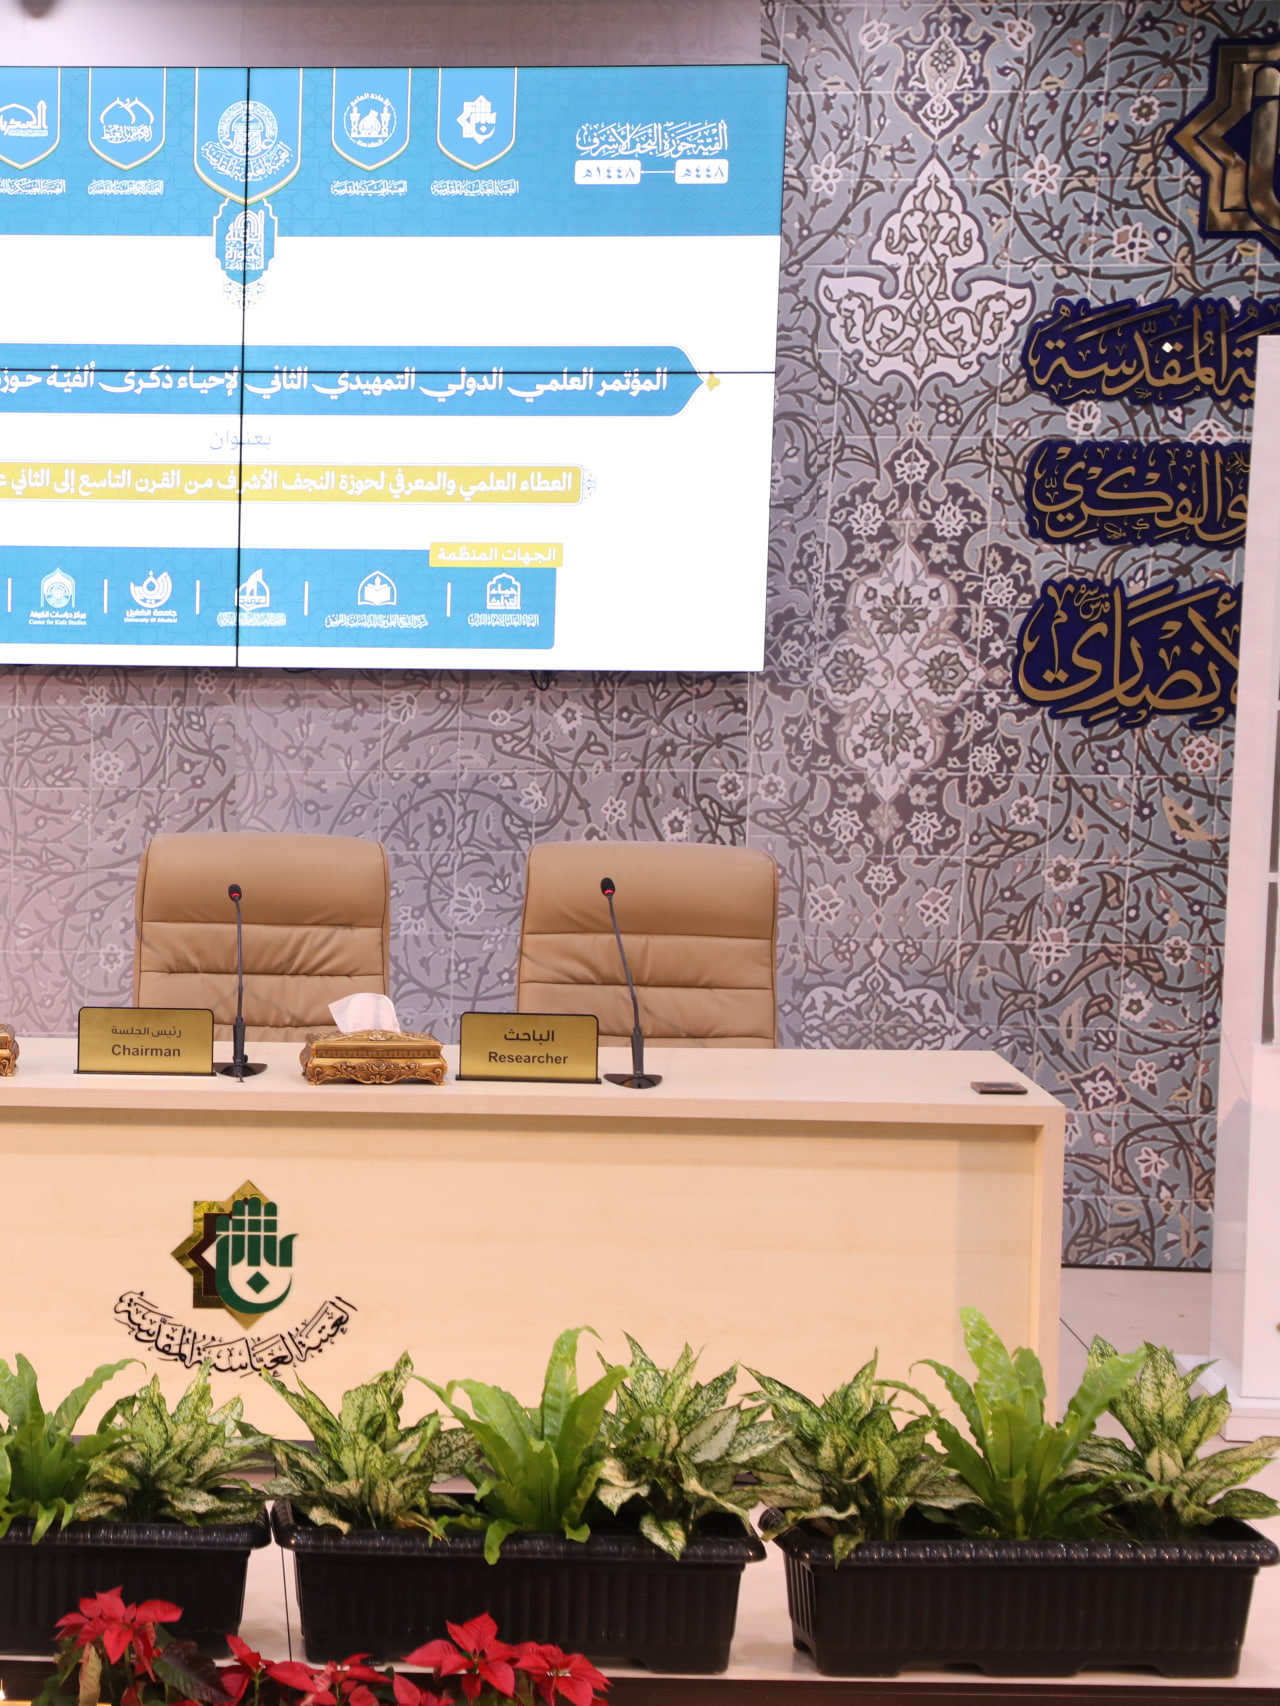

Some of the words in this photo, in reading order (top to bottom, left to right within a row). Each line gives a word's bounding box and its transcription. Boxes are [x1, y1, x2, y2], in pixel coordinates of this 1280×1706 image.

[177, 366, 240, 396] لإحياء
[244, 365, 307, 400] الثاني
[312, 367, 415, 400] التمهيدي
[419, 367, 503, 402] الدولي
[507, 367, 593, 402] العلمي
[597, 367, 667, 397] المؤتمر
[10, 469, 50, 494] الثاني
[53, 470, 75, 495] إلى
[80, 470, 131, 496] التاسع
[135, 471, 181, 494] القرن
[185, 474, 214, 494] من
[217, 468, 278, 494] الأشرف
[284, 470, 335, 491] النجف
[339, 471, 385, 494] لحوزة
[389, 468, 456, 499] والمعرفي
[459, 471, 516, 500] العلمي
[520, 471, 572, 492] العطاء
[501, 548, 556, 565] الجهات
[111, 1025, 150, 1037] الجلسة
[151, 1026, 182, 1039] رئيس
[503, 1028, 555, 1045] الباحث
[111, 1044, 181, 1058] Chairman
[488, 1051, 569, 1065] Researcher
